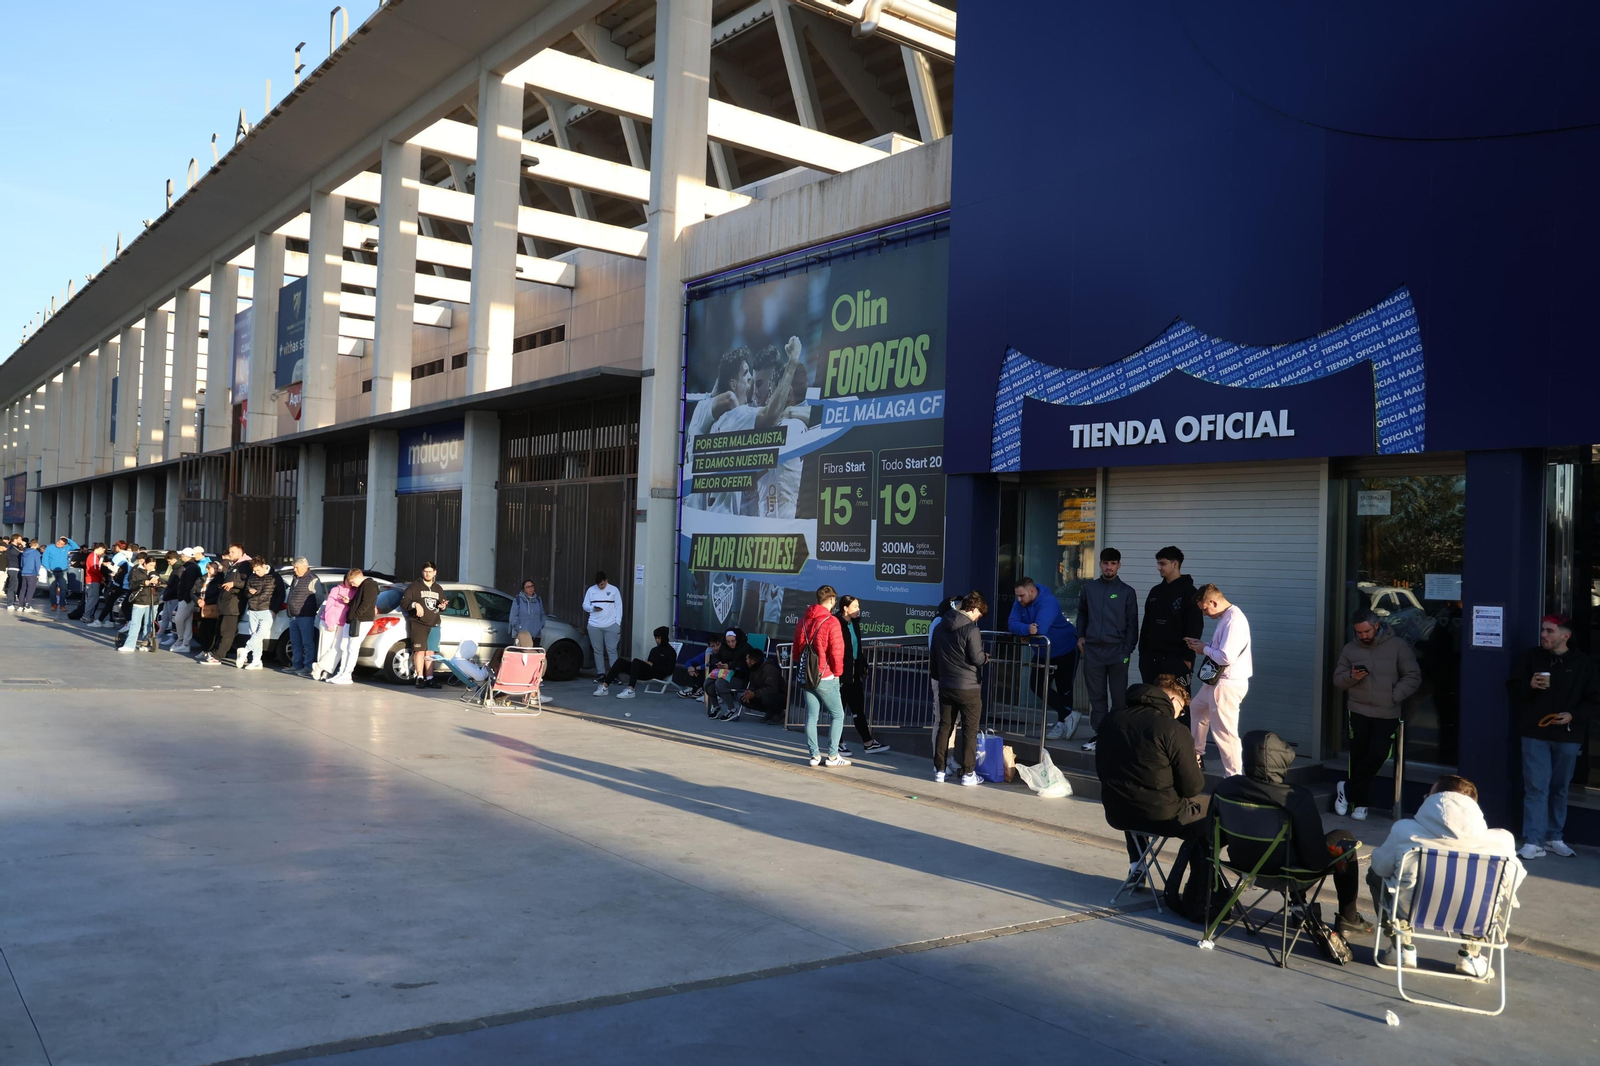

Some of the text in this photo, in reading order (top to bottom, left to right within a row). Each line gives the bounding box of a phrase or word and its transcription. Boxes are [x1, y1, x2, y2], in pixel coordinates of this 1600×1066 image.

[831, 289, 888, 332] Olin
[1316, 323, 1345, 339] TIENDA
[1345, 308, 1376, 326] OFICIAL
[1321, 339, 1350, 356] TIENDA
[1350, 325, 1381, 343] OFICIAL
[1122, 350, 1144, 364] TIENDA
[1144, 338, 1168, 353] OFICIAL
[1125, 364, 1147, 378] TIENDA
[1148, 353, 1171, 367] OFICIAL
[1172, 339, 1199, 356] MALAGA
[1215, 345, 1240, 360] TIENDA
[1325, 356, 1355, 372] TIENDA
[1354, 342, 1386, 360] OFICIAL
[824, 334, 930, 397] FOROFOS
[1009, 361, 1031, 376] MALAGA
[1218, 361, 1244, 376] TIENDA
[1244, 348, 1271, 364] OFICIAL
[1248, 364, 1275, 380] OFICIAL
[1275, 349, 1307, 368] MALAGA
[1308, 345, 1317, 353] CF
[1044, 367, 1063, 380] TIENDA
[1280, 366, 1312, 384] MALAGA
[1312, 361, 1322, 369] CF
[1012, 374, 1034, 389] MALAGA
[1046, 381, 1066, 394] TIENDA
[1066, 370, 1087, 384] OFICIAL
[1069, 384, 1090, 398] OFICIAL
[1090, 372, 1115, 387] MALAGA
[1129, 379, 1151, 393] TIENDA
[1093, 386, 1118, 402] MALAGA
[825, 395, 943, 425] DEL MÁLAGA CF
[996, 399, 1015, 412] OFICIAL
[998, 413, 1017, 425] OFICIAL
[1376, 411, 1408, 428] OFICIAL
[1001, 426, 1020, 438] OFICIAL
[1070, 409, 1295, 448] TIENDA OFICIAL
[1382, 429, 1414, 445] OFICIAL
[695, 430, 785, 450] POR SER MALAGUISTA,
[695, 453, 774, 470] TE DAMOS NUESTRA
[823, 461, 866, 474] Fibra Start
[881, 456, 943, 470] Todo Start 20
[694, 476, 752, 490] MEJOR OFERTA
[820, 486, 863, 526] 15 €
[880, 483, 928, 526] 19 €
[691, 536, 798, 574] ¡VA POR USTEDES!
[820, 541, 849, 552] 300Mb
[882, 542, 914, 554] 300Mb
[882, 562, 907, 575] 20GB
[906, 607, 936, 617] Llámanos
